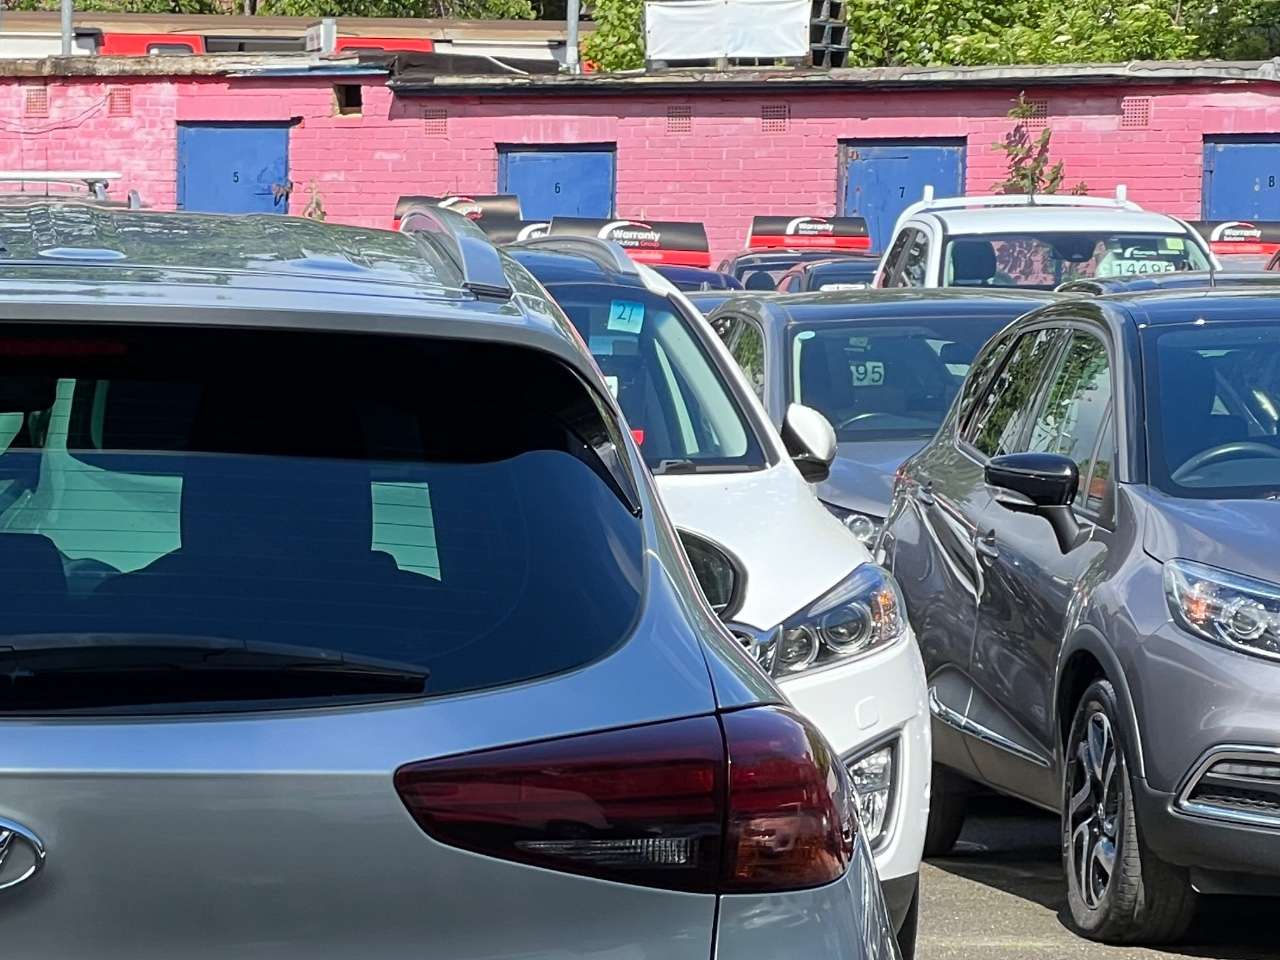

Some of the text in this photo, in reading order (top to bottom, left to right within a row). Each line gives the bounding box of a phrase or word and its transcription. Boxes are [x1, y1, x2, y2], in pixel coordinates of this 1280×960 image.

[233, 171, 239, 183] 5
[1268, 175, 1275, 187] 8
[555, 182, 561, 194] 6
[899, 186, 905, 198] 7
[613, 229, 661, 242] Warranty
[1223, 228, 1262, 238] Warranty
